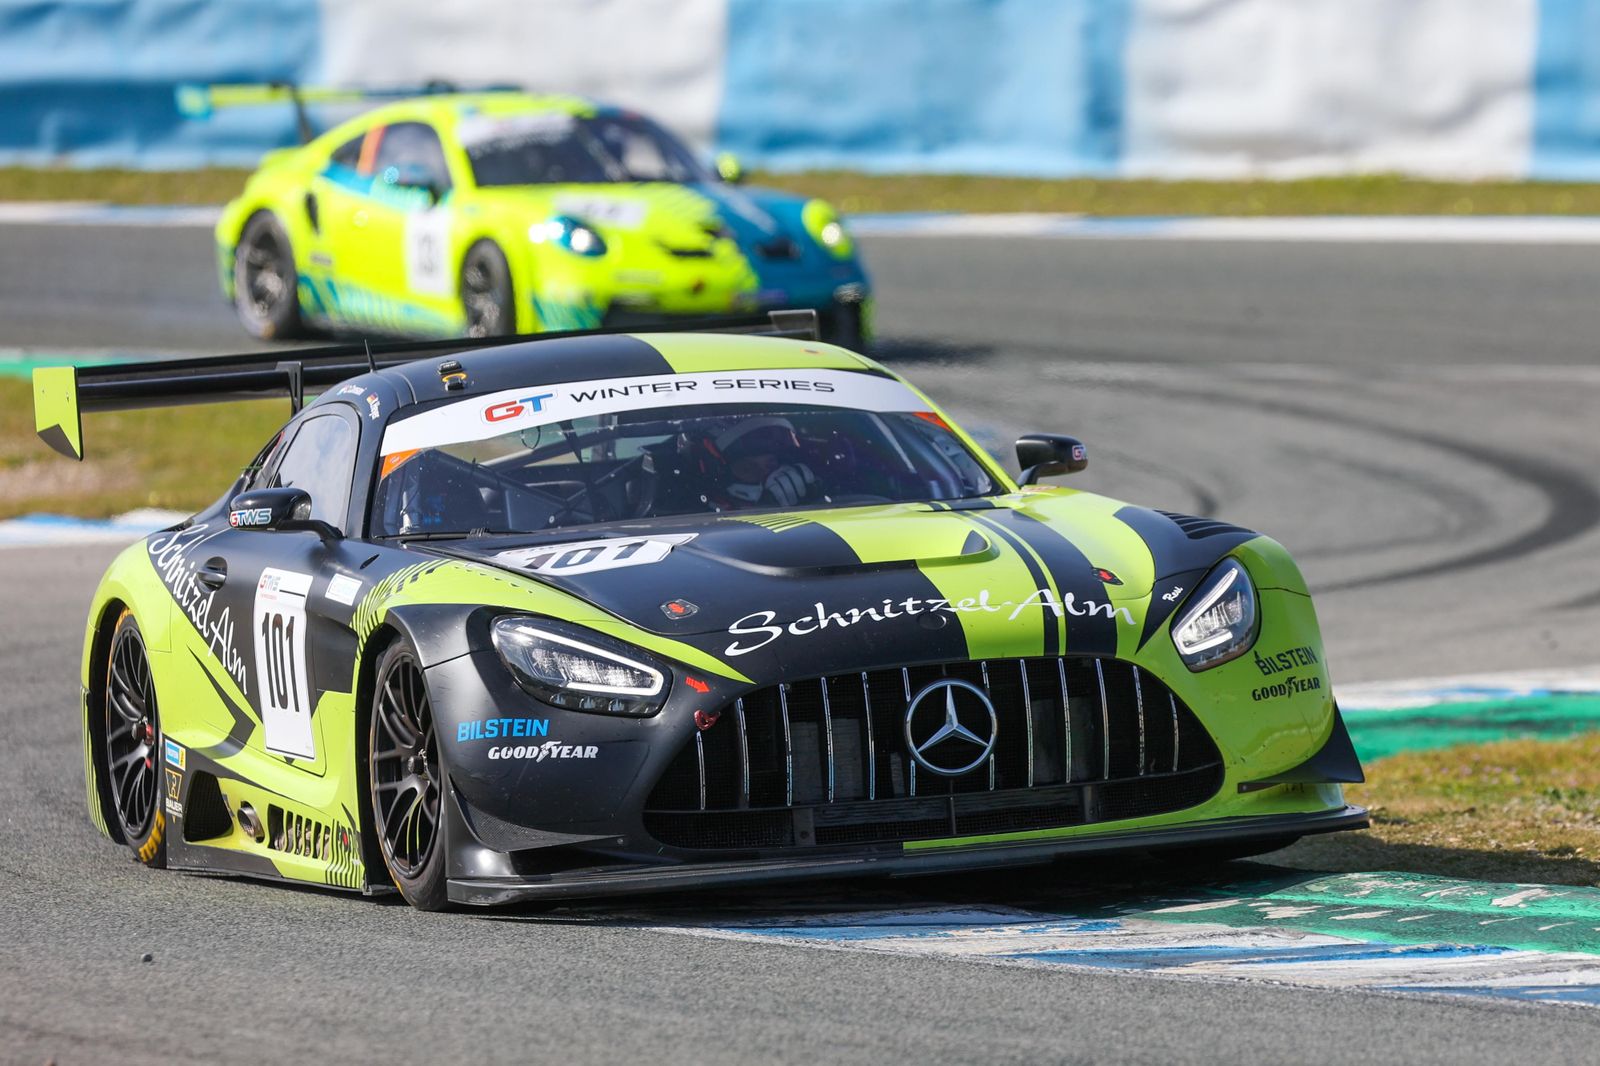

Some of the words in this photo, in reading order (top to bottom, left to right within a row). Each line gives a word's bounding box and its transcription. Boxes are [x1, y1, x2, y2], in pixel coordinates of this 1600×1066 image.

[484, 393, 553, 422] GT
[571, 380, 698, 403] WINTER
[712, 379, 835, 393] SERIES
[229, 508, 272, 527] GTWS
[522, 539, 649, 570] 101
[261, 612, 300, 713] 101
[1254, 645, 1318, 676] BILSTEIN
[1251, 676, 1321, 702] GOODYEAR
[456, 717, 549, 742] BILSTEIN
[487, 740, 599, 763] GOODYEAR
